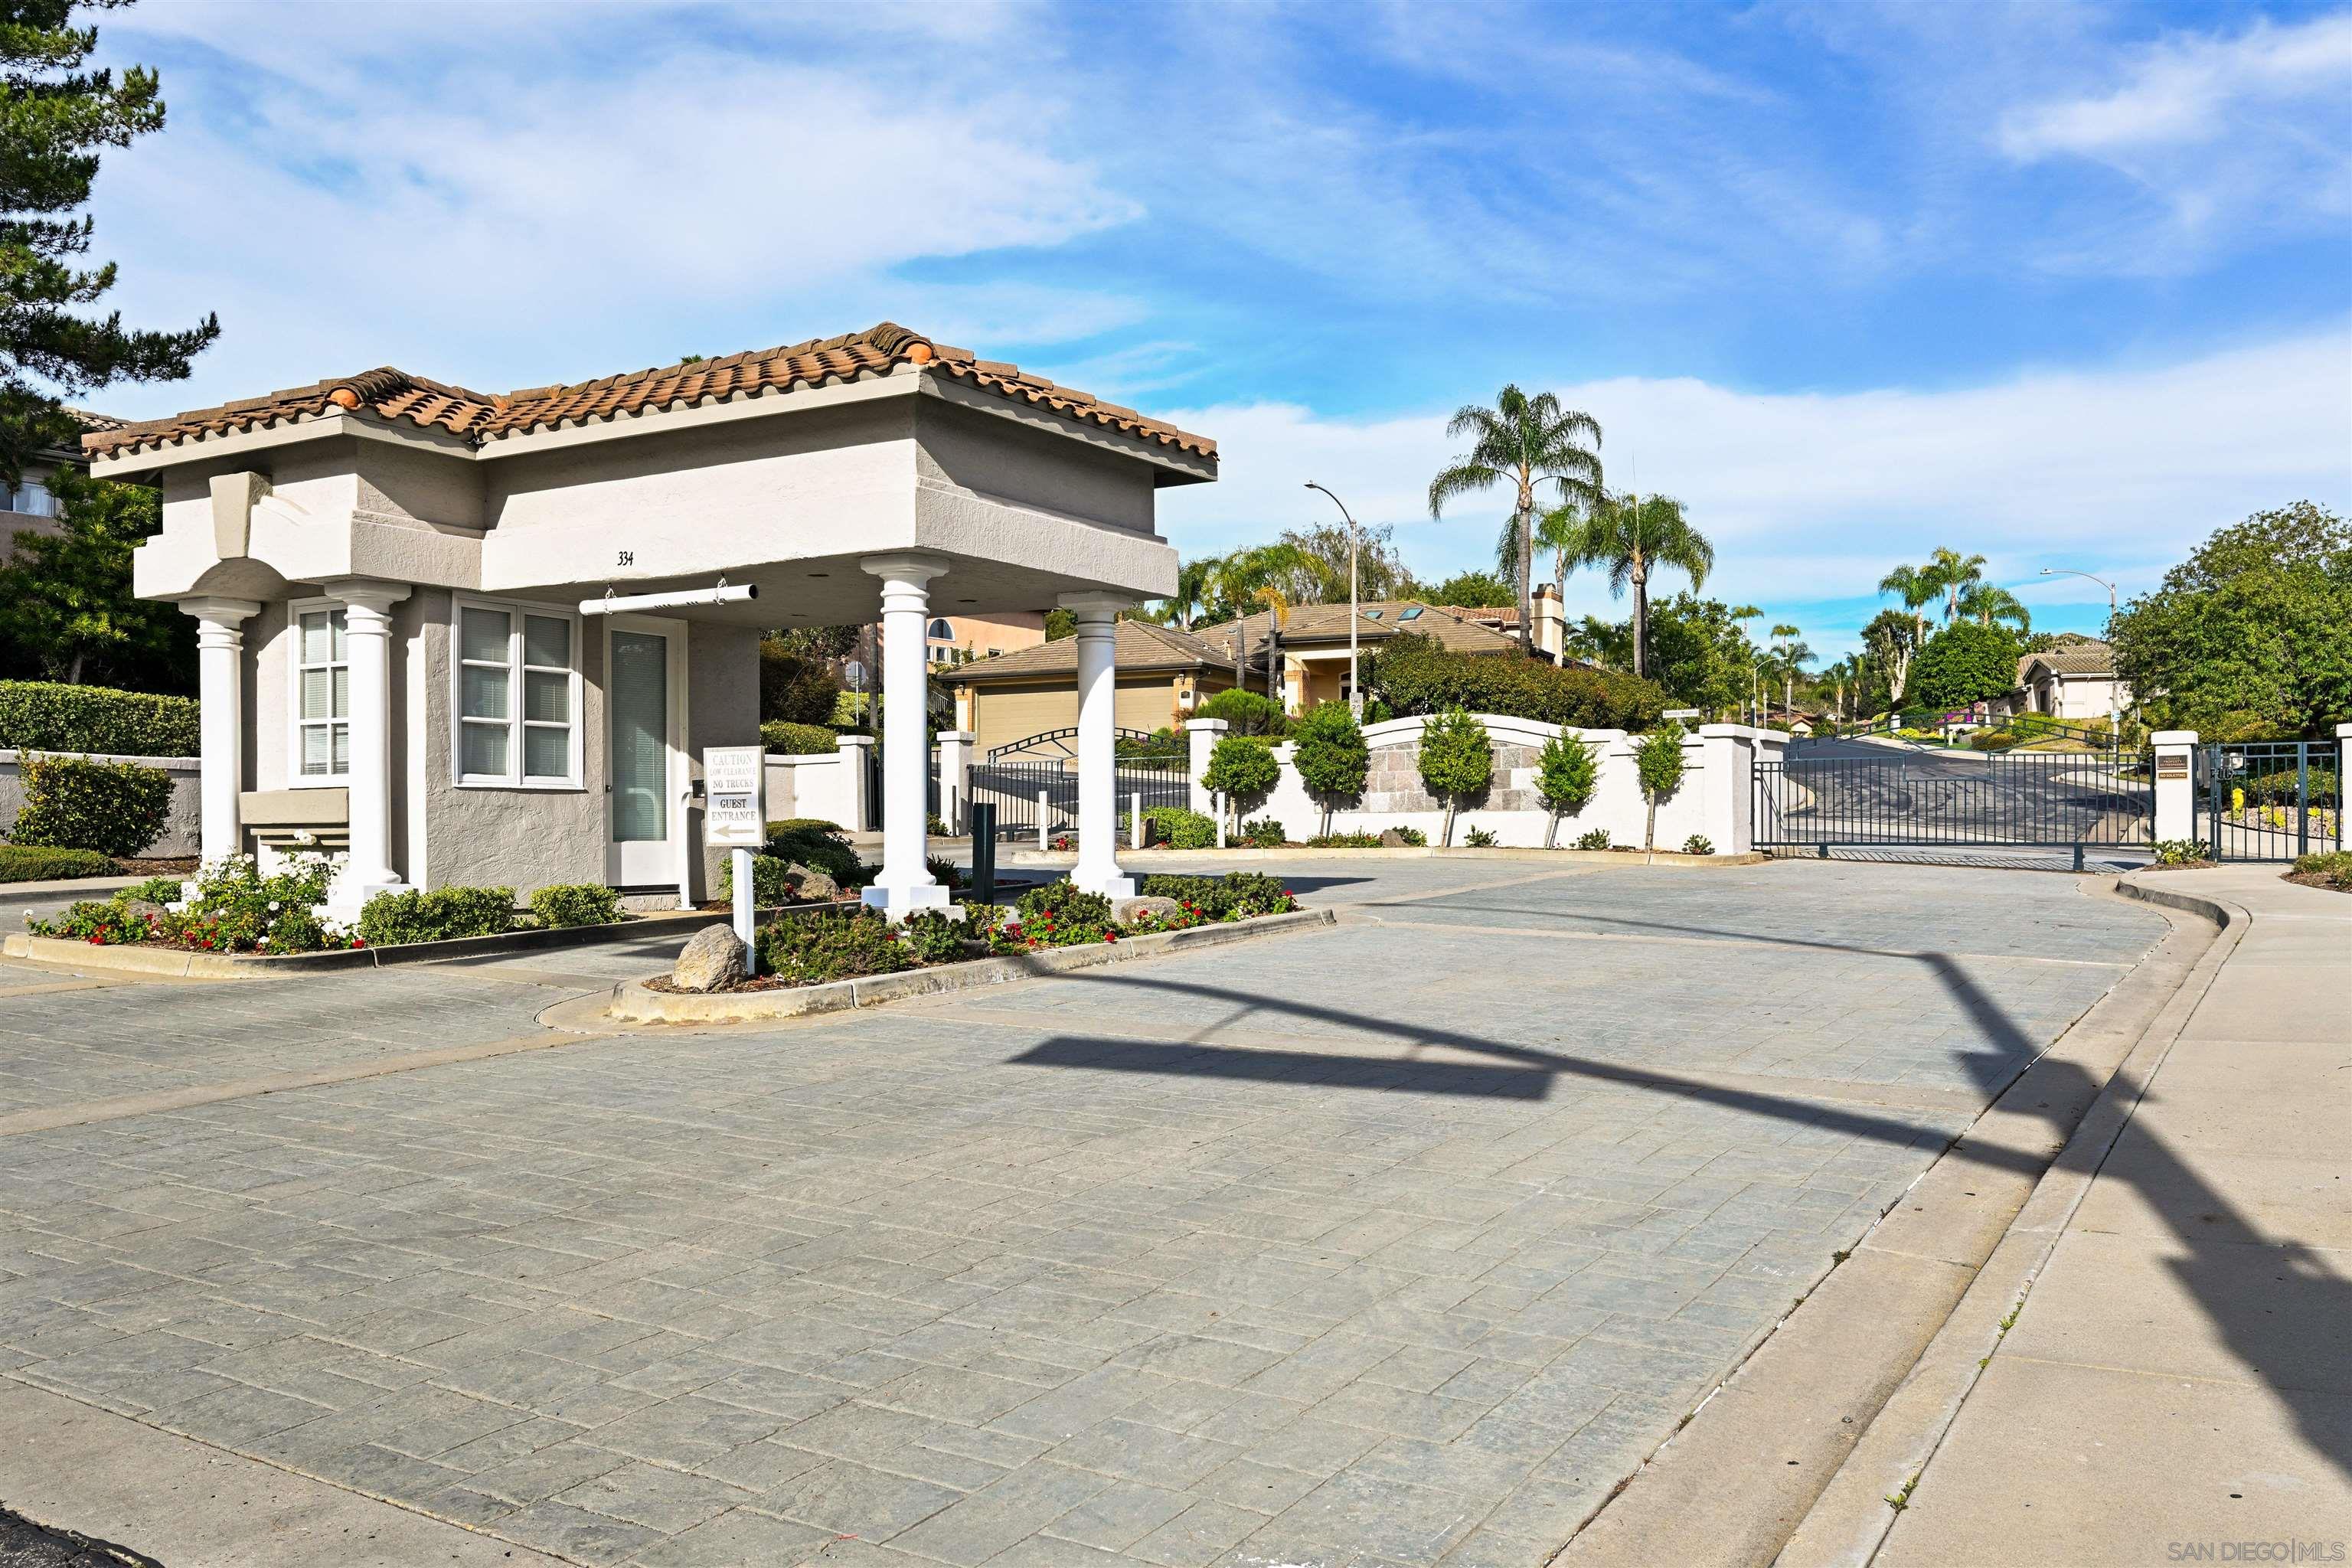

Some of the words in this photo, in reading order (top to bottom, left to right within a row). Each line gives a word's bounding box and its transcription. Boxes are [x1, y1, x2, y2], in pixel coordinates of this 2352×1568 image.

[617, 551, 633, 566] 334
[713, 754, 753, 766] CAUTION
[724, 767, 756, 776] CLEARANE
[713, 779, 724, 789] NO
[727, 779, 754, 789] TRUCKS
[720, 799, 747, 808] GUEST
[712, 812, 756, 821] ENTRANCE
